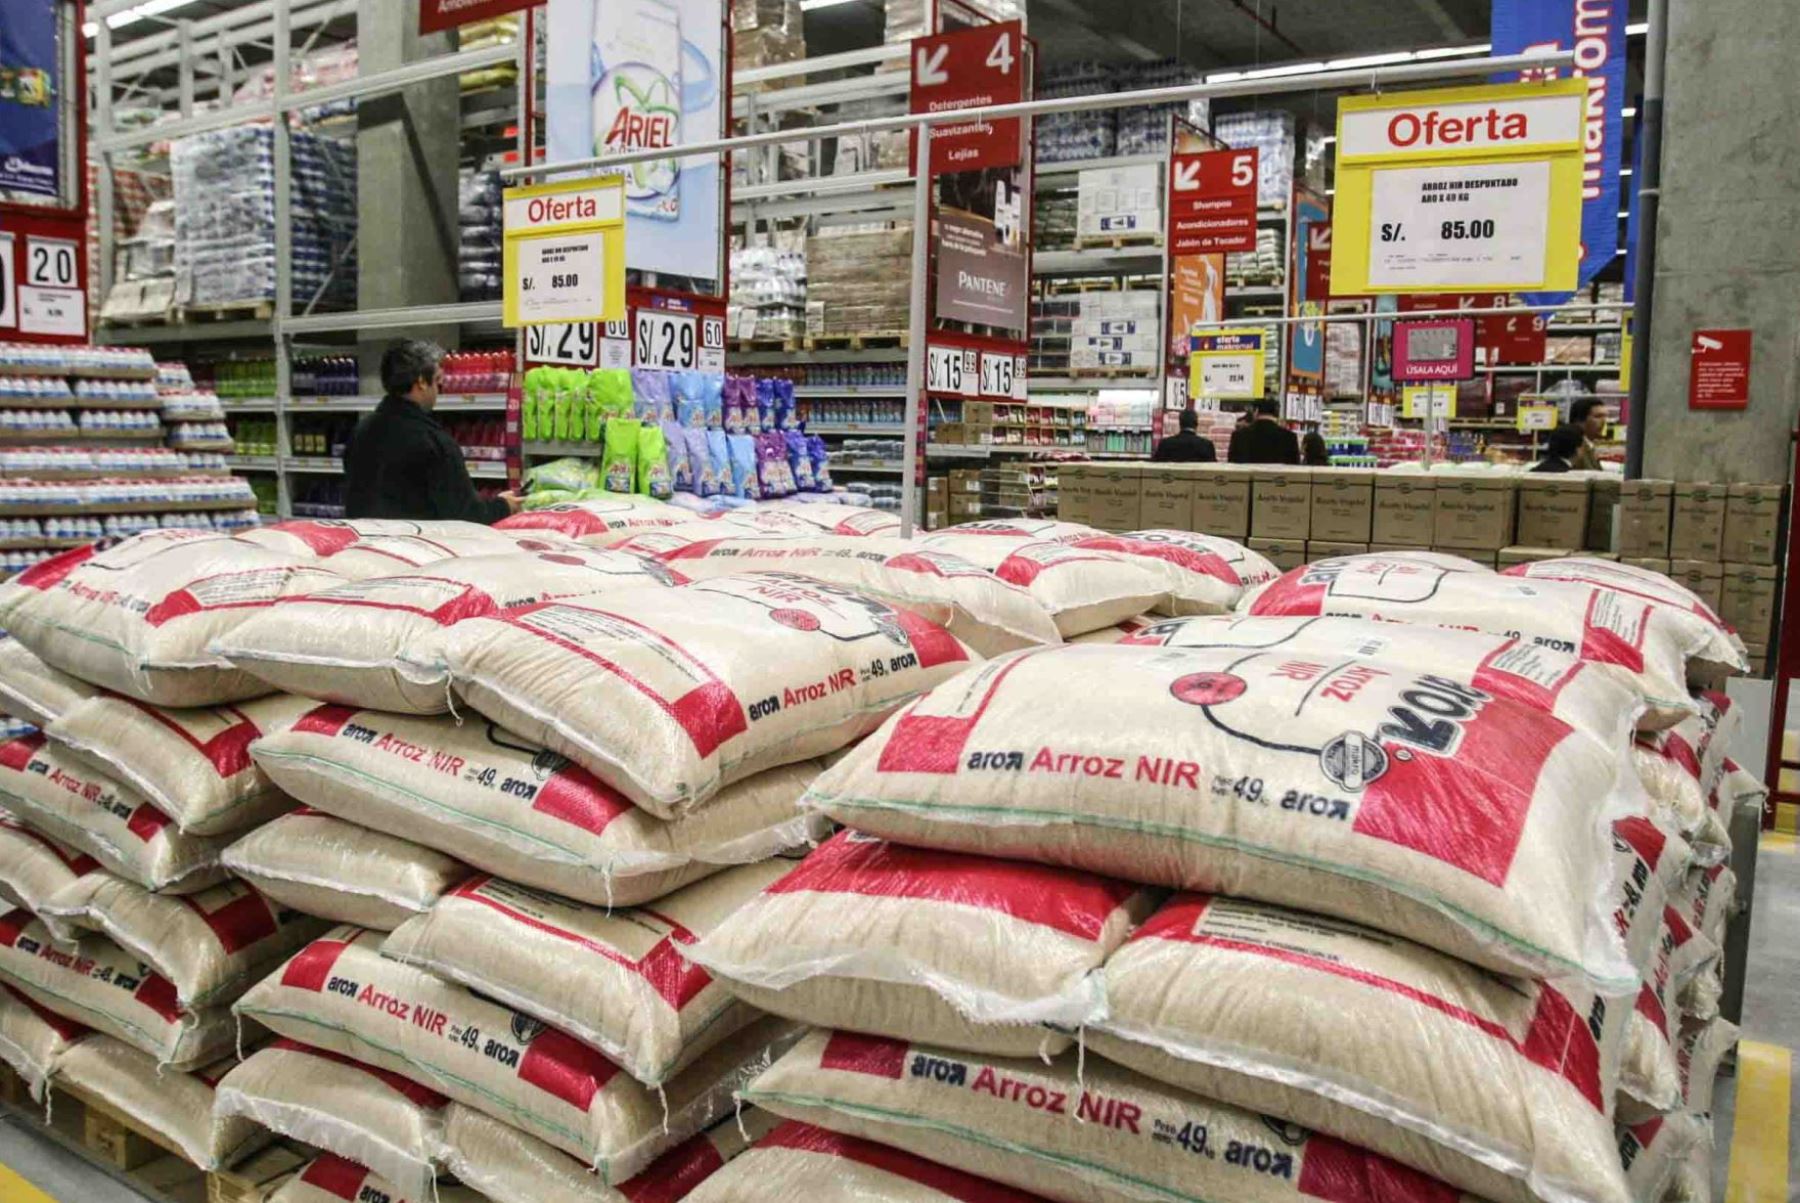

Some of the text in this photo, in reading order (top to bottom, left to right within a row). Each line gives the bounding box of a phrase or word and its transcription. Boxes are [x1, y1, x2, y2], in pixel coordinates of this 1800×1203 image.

[985, 32, 1015, 75] 4
[929, 95, 993, 111] Detergentes
[604, 106, 673, 149] ARIEL
[1387, 108, 1528, 147] Oferta
[1231, 155, 1254, 187] 5
[528, 195, 597, 223] Oferta
[1176, 217, 1249, 230] Acondicionadores
[1381, 219, 1495, 242] S/. 85.00
[1202, 238, 1212, 246] de
[552, 273, 578, 288] 85.00
[958, 271, 1006, 297] PANTENE
[705, 321, 721, 347] 60
[783, 682, 827, 709] Arroz
[373, 732, 426, 763] Arroz
[427, 750, 466, 777] NIR
[1029, 746, 1125, 779] Arroz
[1135, 755, 1200, 791] NIR
[1233, 775, 1264, 803] 49
[357, 984, 411, 1020] Arroz
[412, 1005, 448, 1037] NIR
[461, 1026, 479, 1049] 49
[971, 1064, 1067, 1115] Arroz
[1075, 1090, 1143, 1135] NIR
[1177, 1121, 1207, 1154] 49
